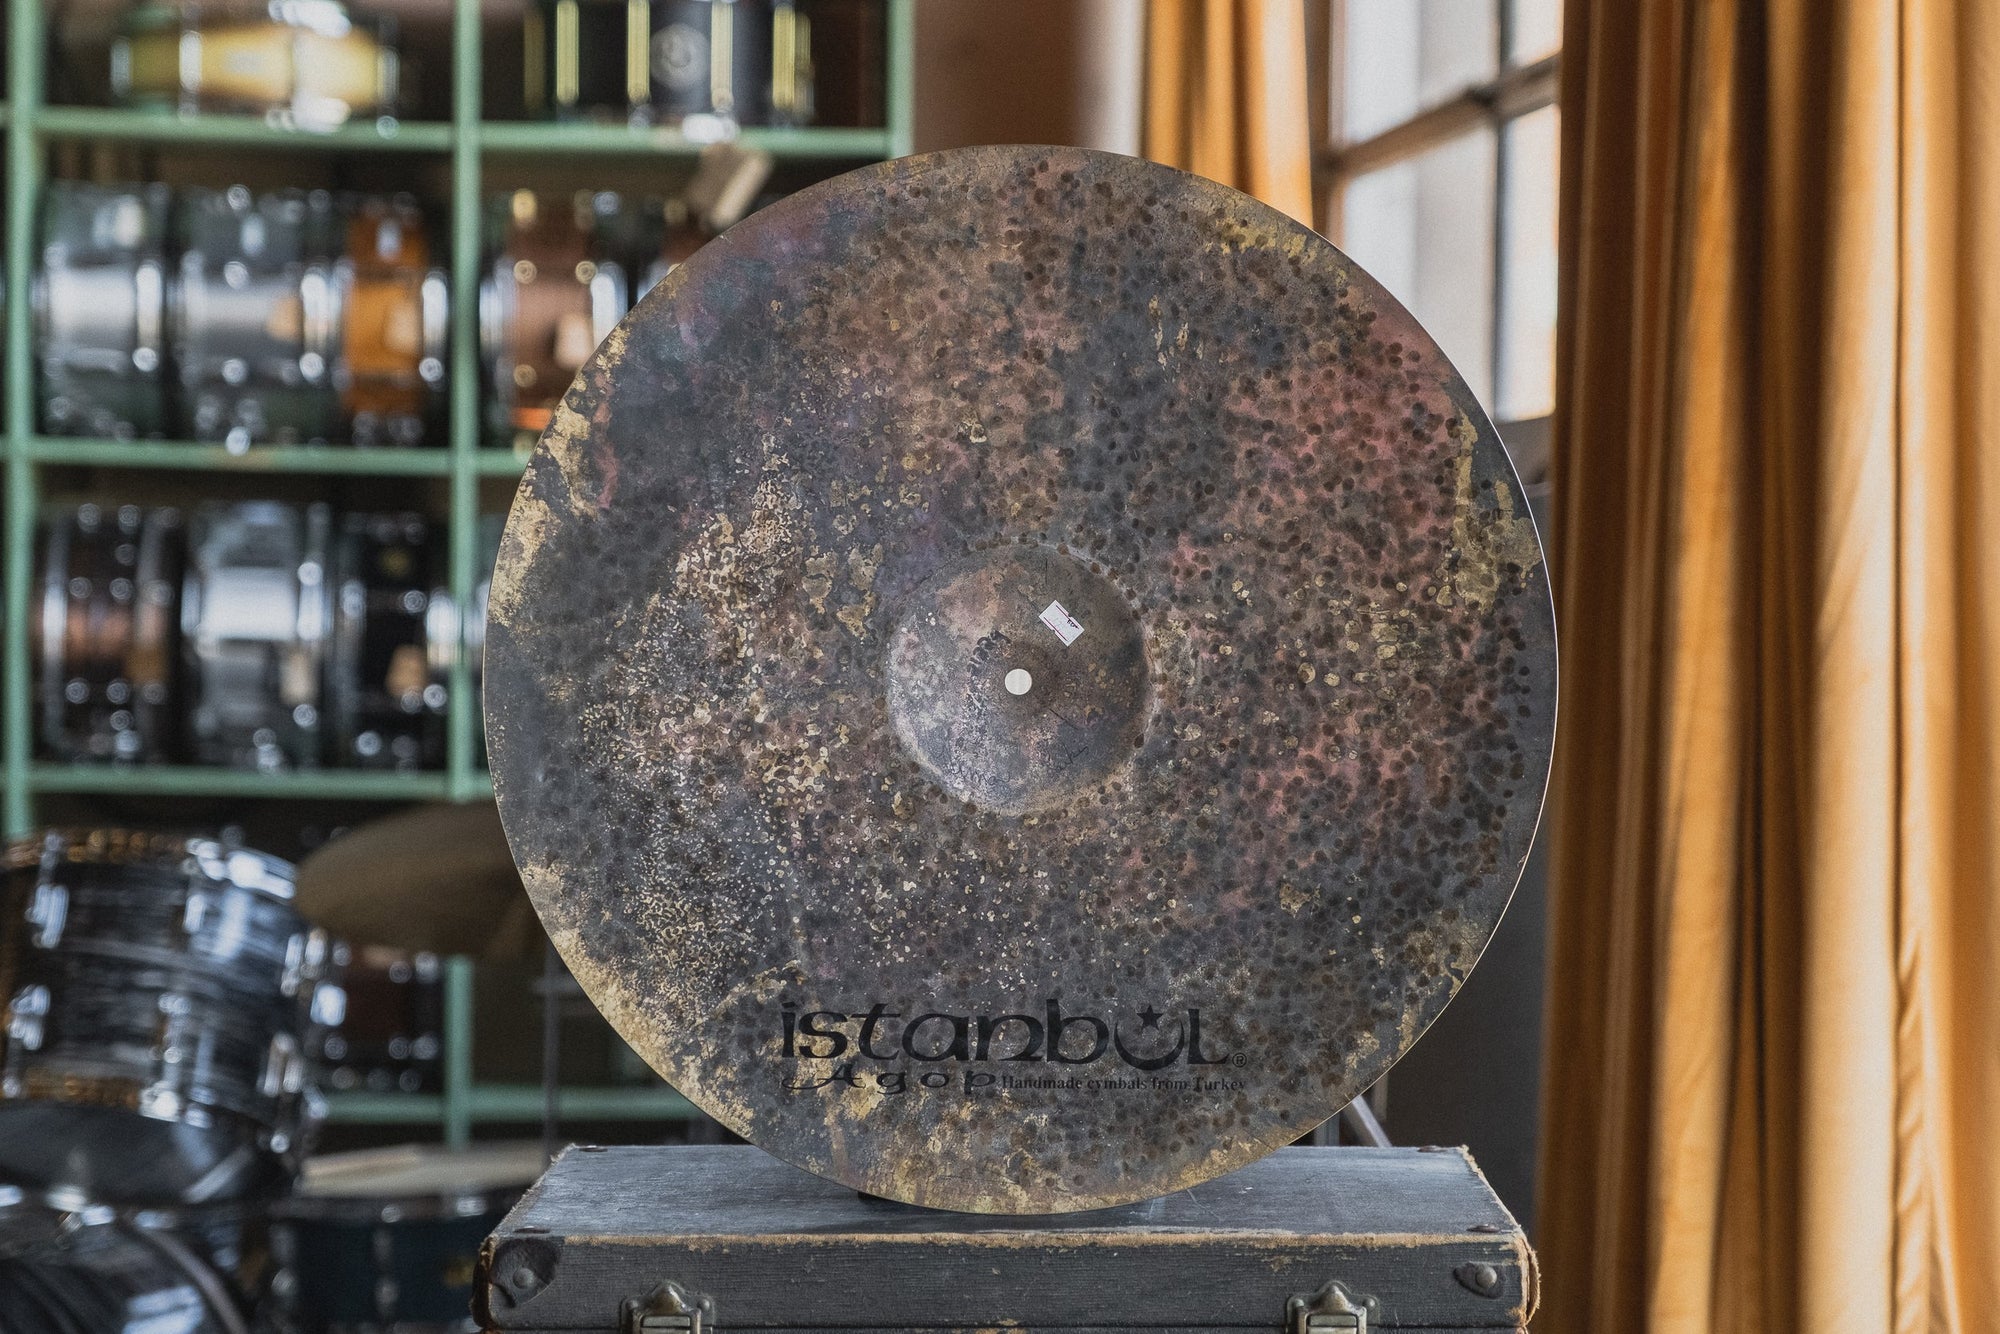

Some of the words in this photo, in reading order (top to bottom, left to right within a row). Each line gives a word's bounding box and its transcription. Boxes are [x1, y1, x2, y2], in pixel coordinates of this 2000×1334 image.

[782, 1064, 996, 1095] Agop
[1001, 1076, 1082, 1090] Handmade
[1087, 1077, 1147, 1093] cymbals
[1152, 1077, 1188, 1090] from
[1192, 1077, 1246, 1094] Turkey
